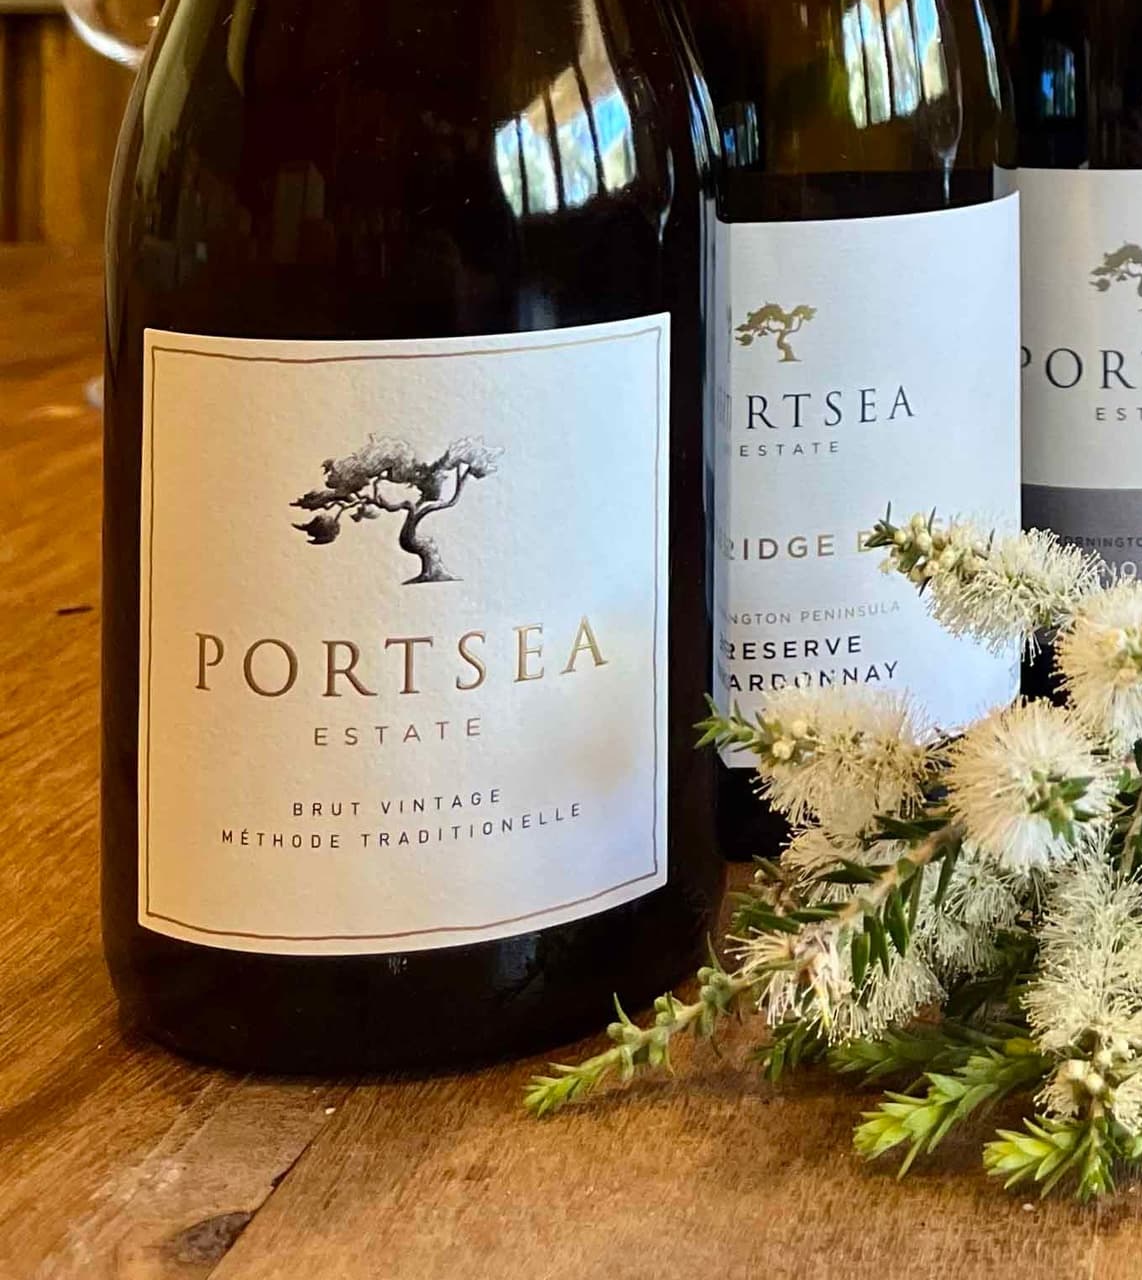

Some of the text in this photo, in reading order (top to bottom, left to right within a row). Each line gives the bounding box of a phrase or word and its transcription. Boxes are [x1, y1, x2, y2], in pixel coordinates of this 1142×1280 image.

[745, 385, 915, 430] RTSEA
[739, 441, 839, 457] ESTATE
[801, 600, 900, 622] PENINSULA
[194, 616, 610, 699] PORTSEA
[314, 717, 482, 746] ESTATE
[292, 789, 501, 817] BRUT VINTAGE
[221, 802, 581, 849] MÉTHODE TRADITIONELLE
